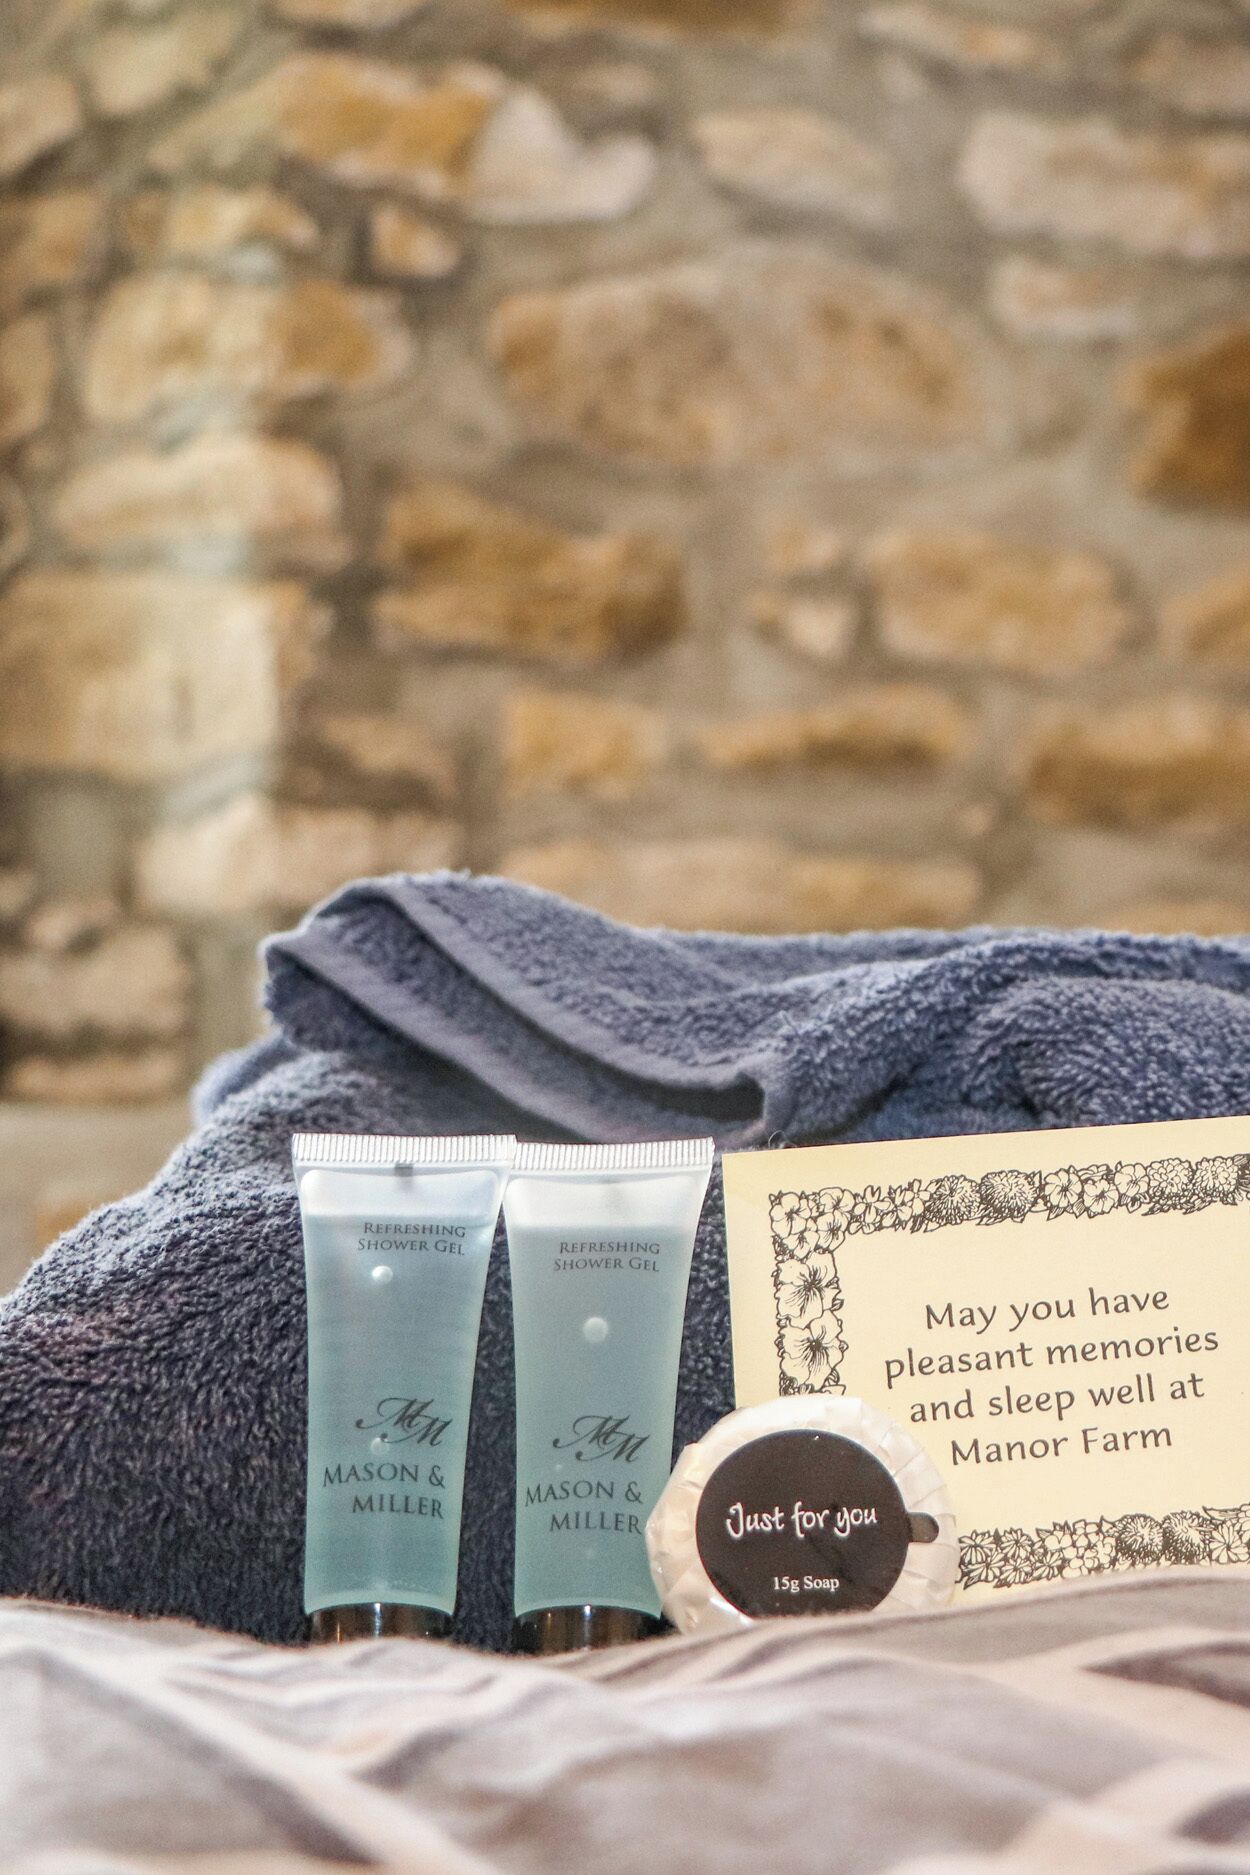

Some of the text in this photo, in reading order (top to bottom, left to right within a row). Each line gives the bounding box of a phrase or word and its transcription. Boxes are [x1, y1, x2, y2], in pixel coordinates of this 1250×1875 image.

[925, 1287, 1169, 1334] May you have
[885, 1327, 1219, 1389] pleasant memories
[910, 1372, 1205, 1422] and sleep well at
[951, 1426, 1172, 1466] Manor Farm
[323, 1462, 446, 1489] MASON &
[352, 1494, 443, 1519] MILLER
[524, 1480, 643, 1507] MASON &
[549, 1513, 642, 1535] MILLER
[726, 1501, 878, 1538] Just for you
[773, 1575, 839, 1592] 15g Soap
